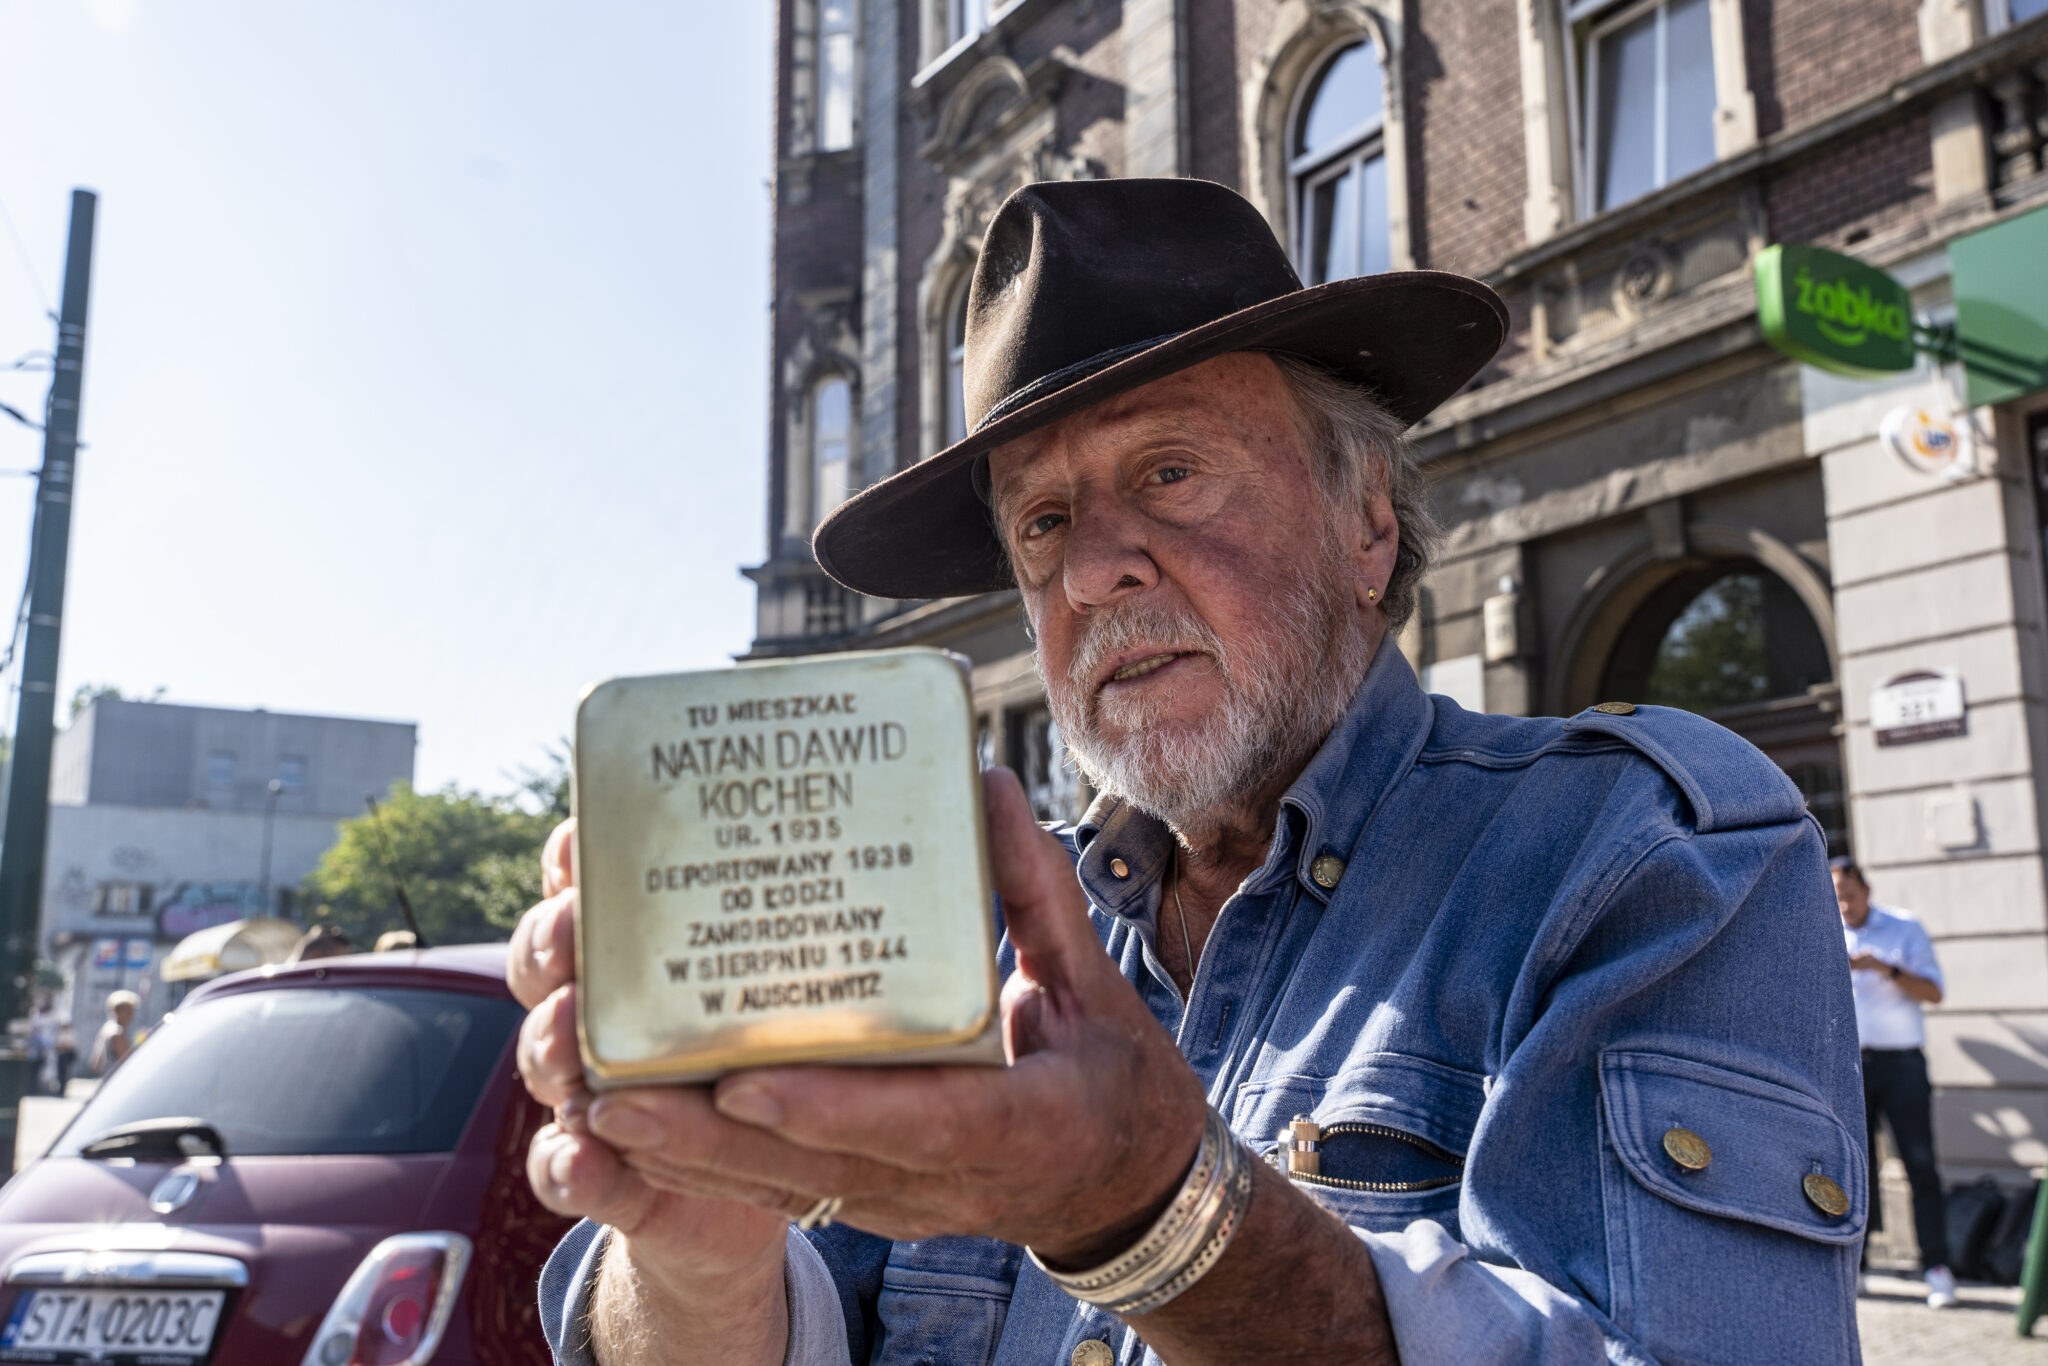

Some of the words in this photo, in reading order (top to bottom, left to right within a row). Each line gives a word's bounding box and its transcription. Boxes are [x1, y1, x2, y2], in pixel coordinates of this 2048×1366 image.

[1795, 266, 1908, 342] żabka
[686, 706, 718, 729] TU
[727, 694, 857, 725] MIESZKAŁ
[651, 736, 767, 784] NATAN
[776, 722, 907, 770] DAWID
[698, 773, 854, 821] KOCHEN
[714, 826, 761, 849] UR.
[770, 818, 842, 842] 1935
[645, 851, 833, 893] DEPORTOWANY
[847, 843, 914, 870] 1938
[721, 887, 754, 912] DO
[765, 879, 845, 910] ŁODZI
[688, 907, 885, 949] ZAMORDOWANY
[665, 958, 690, 982] W
[699, 948, 829, 981] SIERPNIU
[839, 937, 908, 965] 1944
[700, 990, 724, 1015] W
[736, 973, 883, 1013] AUSCHWITZ
[23, 1296, 93, 1343] STA
